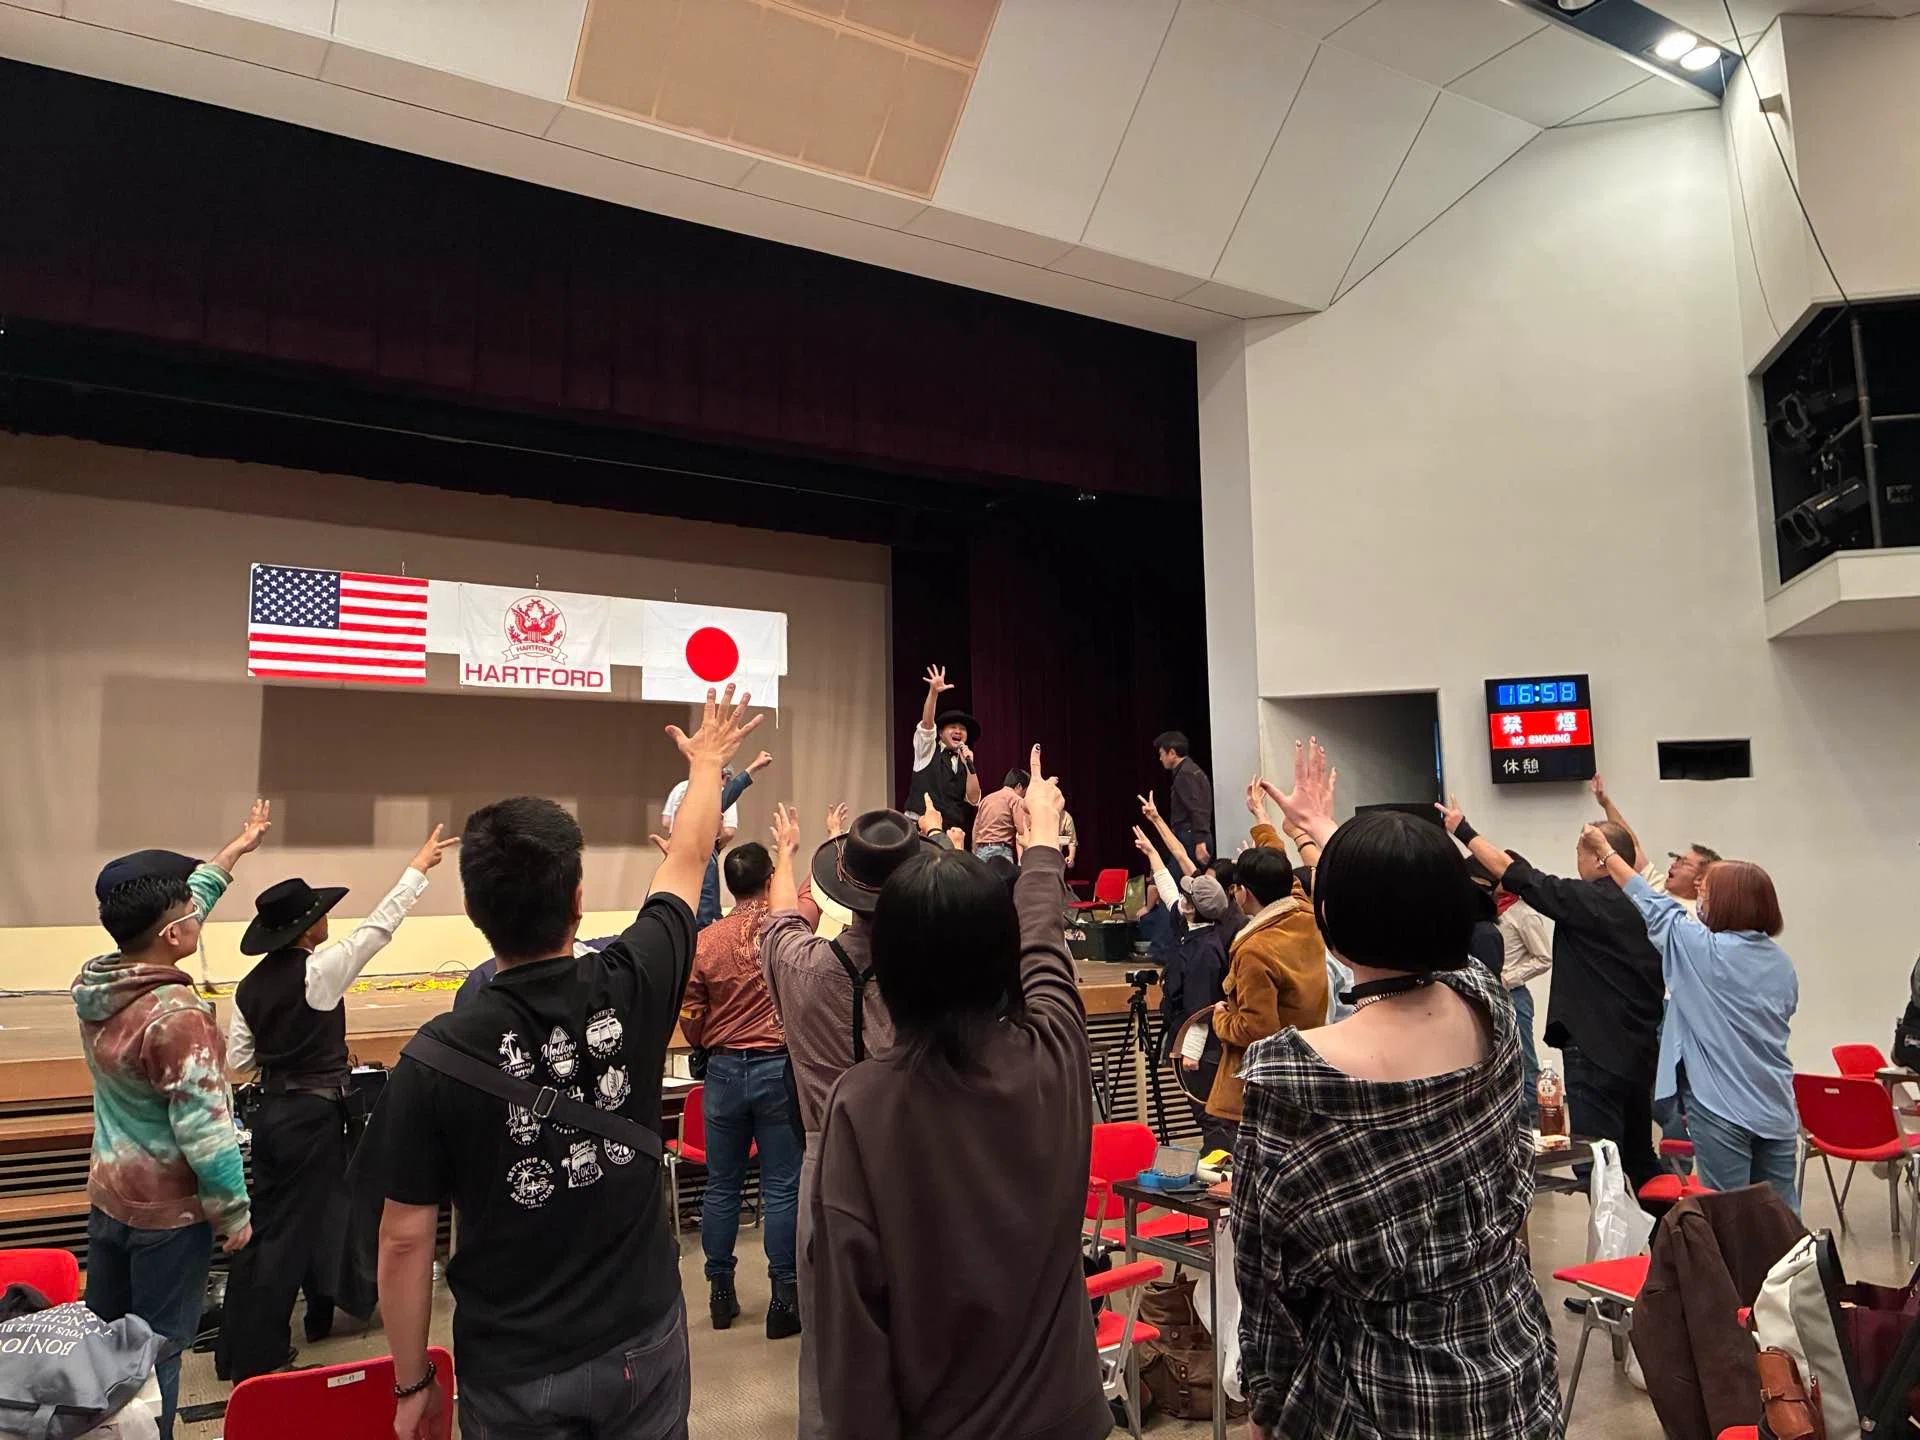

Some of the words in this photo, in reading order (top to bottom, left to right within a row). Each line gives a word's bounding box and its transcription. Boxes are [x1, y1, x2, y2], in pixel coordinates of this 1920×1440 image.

[516, 644, 554, 654] HARTFORD
[465, 663, 604, 688] HARTFORD
[1506, 683, 1575, 703] 16:58
[1511, 735, 1525, 745] NO
[1528, 733, 1571, 745] SMOKING
[1502, 758, 1539, 774] 休憩
[541, 1042, 577, 1062] Mellow
[570, 1139, 591, 1154] Barry
[506, 1157, 538, 1182] SETTING
[540, 1159, 554, 1173] SUN
[510, 1191, 537, 1205] BEACH
[538, 1184, 555, 1202] CLUB
[0, 1322, 15, 1333] BI
[16, 1323, 56, 1334] ALLEZ
[56, 1327, 84, 1340] VOUS
[0, 1334, 77, 1355] BONJO
